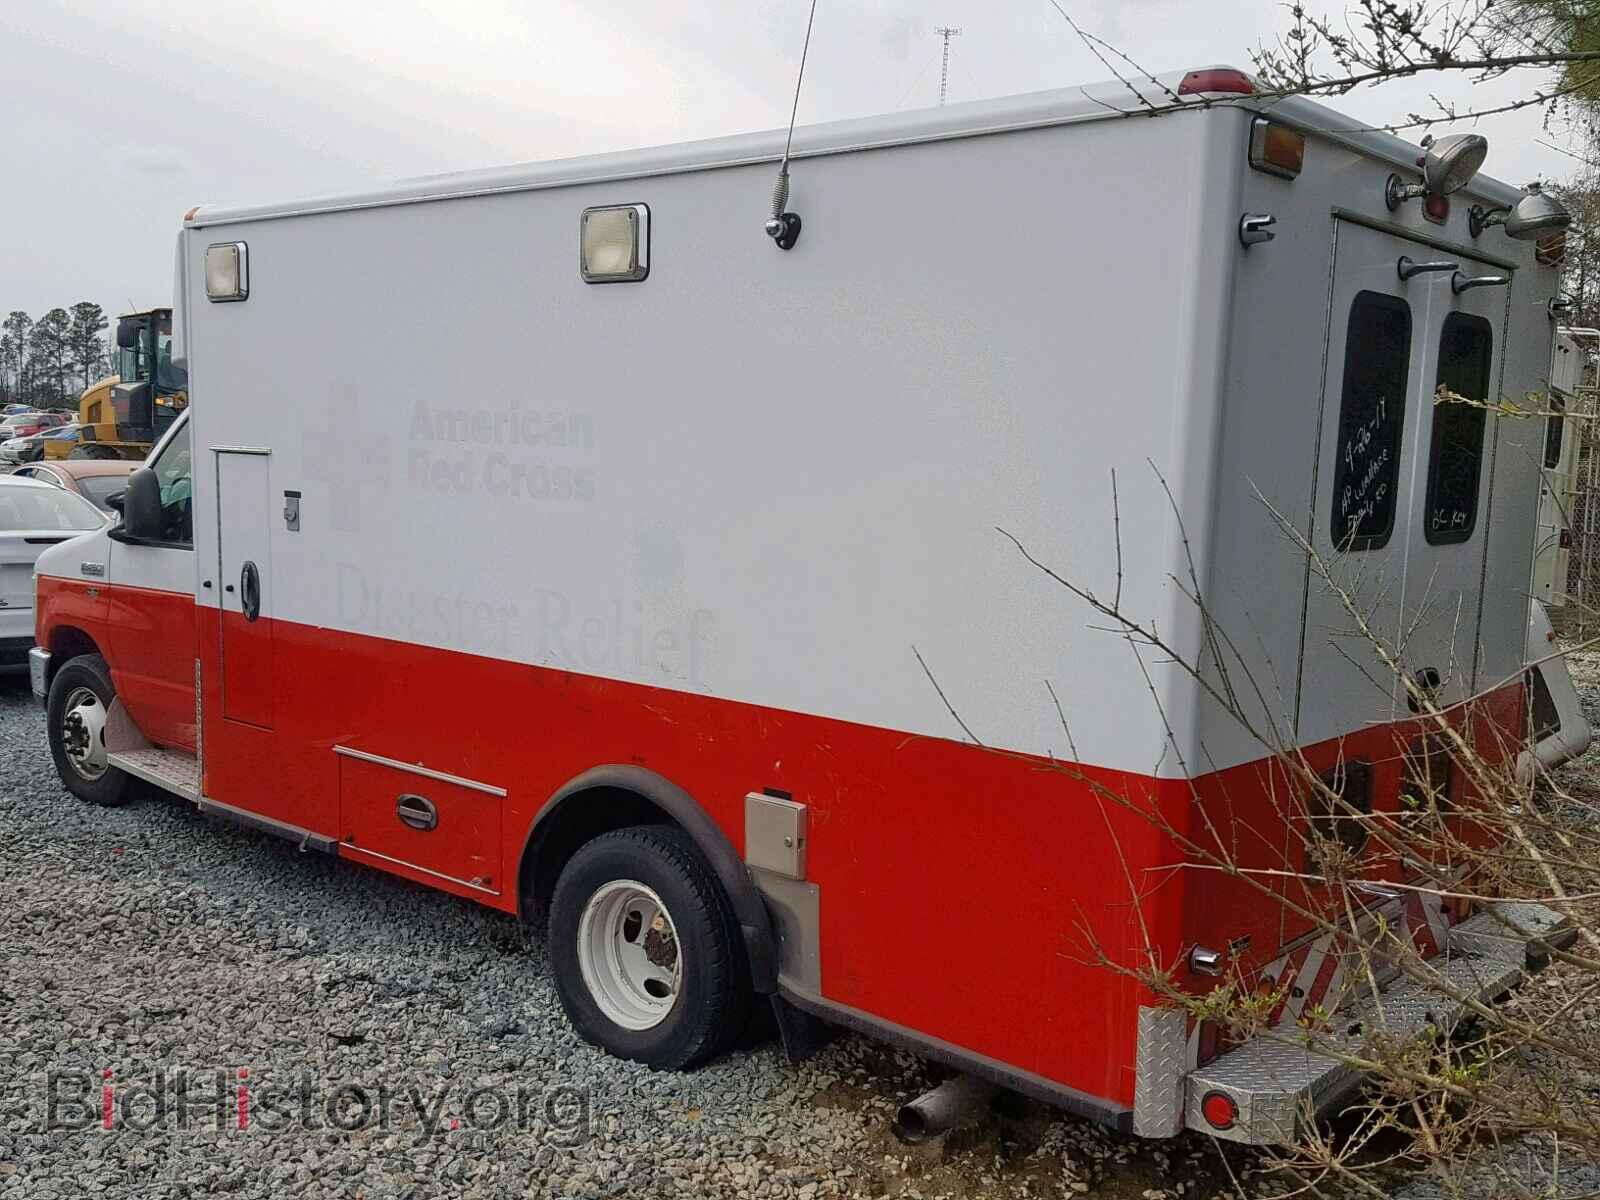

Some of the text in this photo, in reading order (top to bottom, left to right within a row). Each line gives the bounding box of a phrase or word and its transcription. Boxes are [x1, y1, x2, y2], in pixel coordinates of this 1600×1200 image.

[409, 400, 595, 448] American
[408, 449, 597, 502] Red Cross
[336, 563, 717, 688] Disaster Relief
